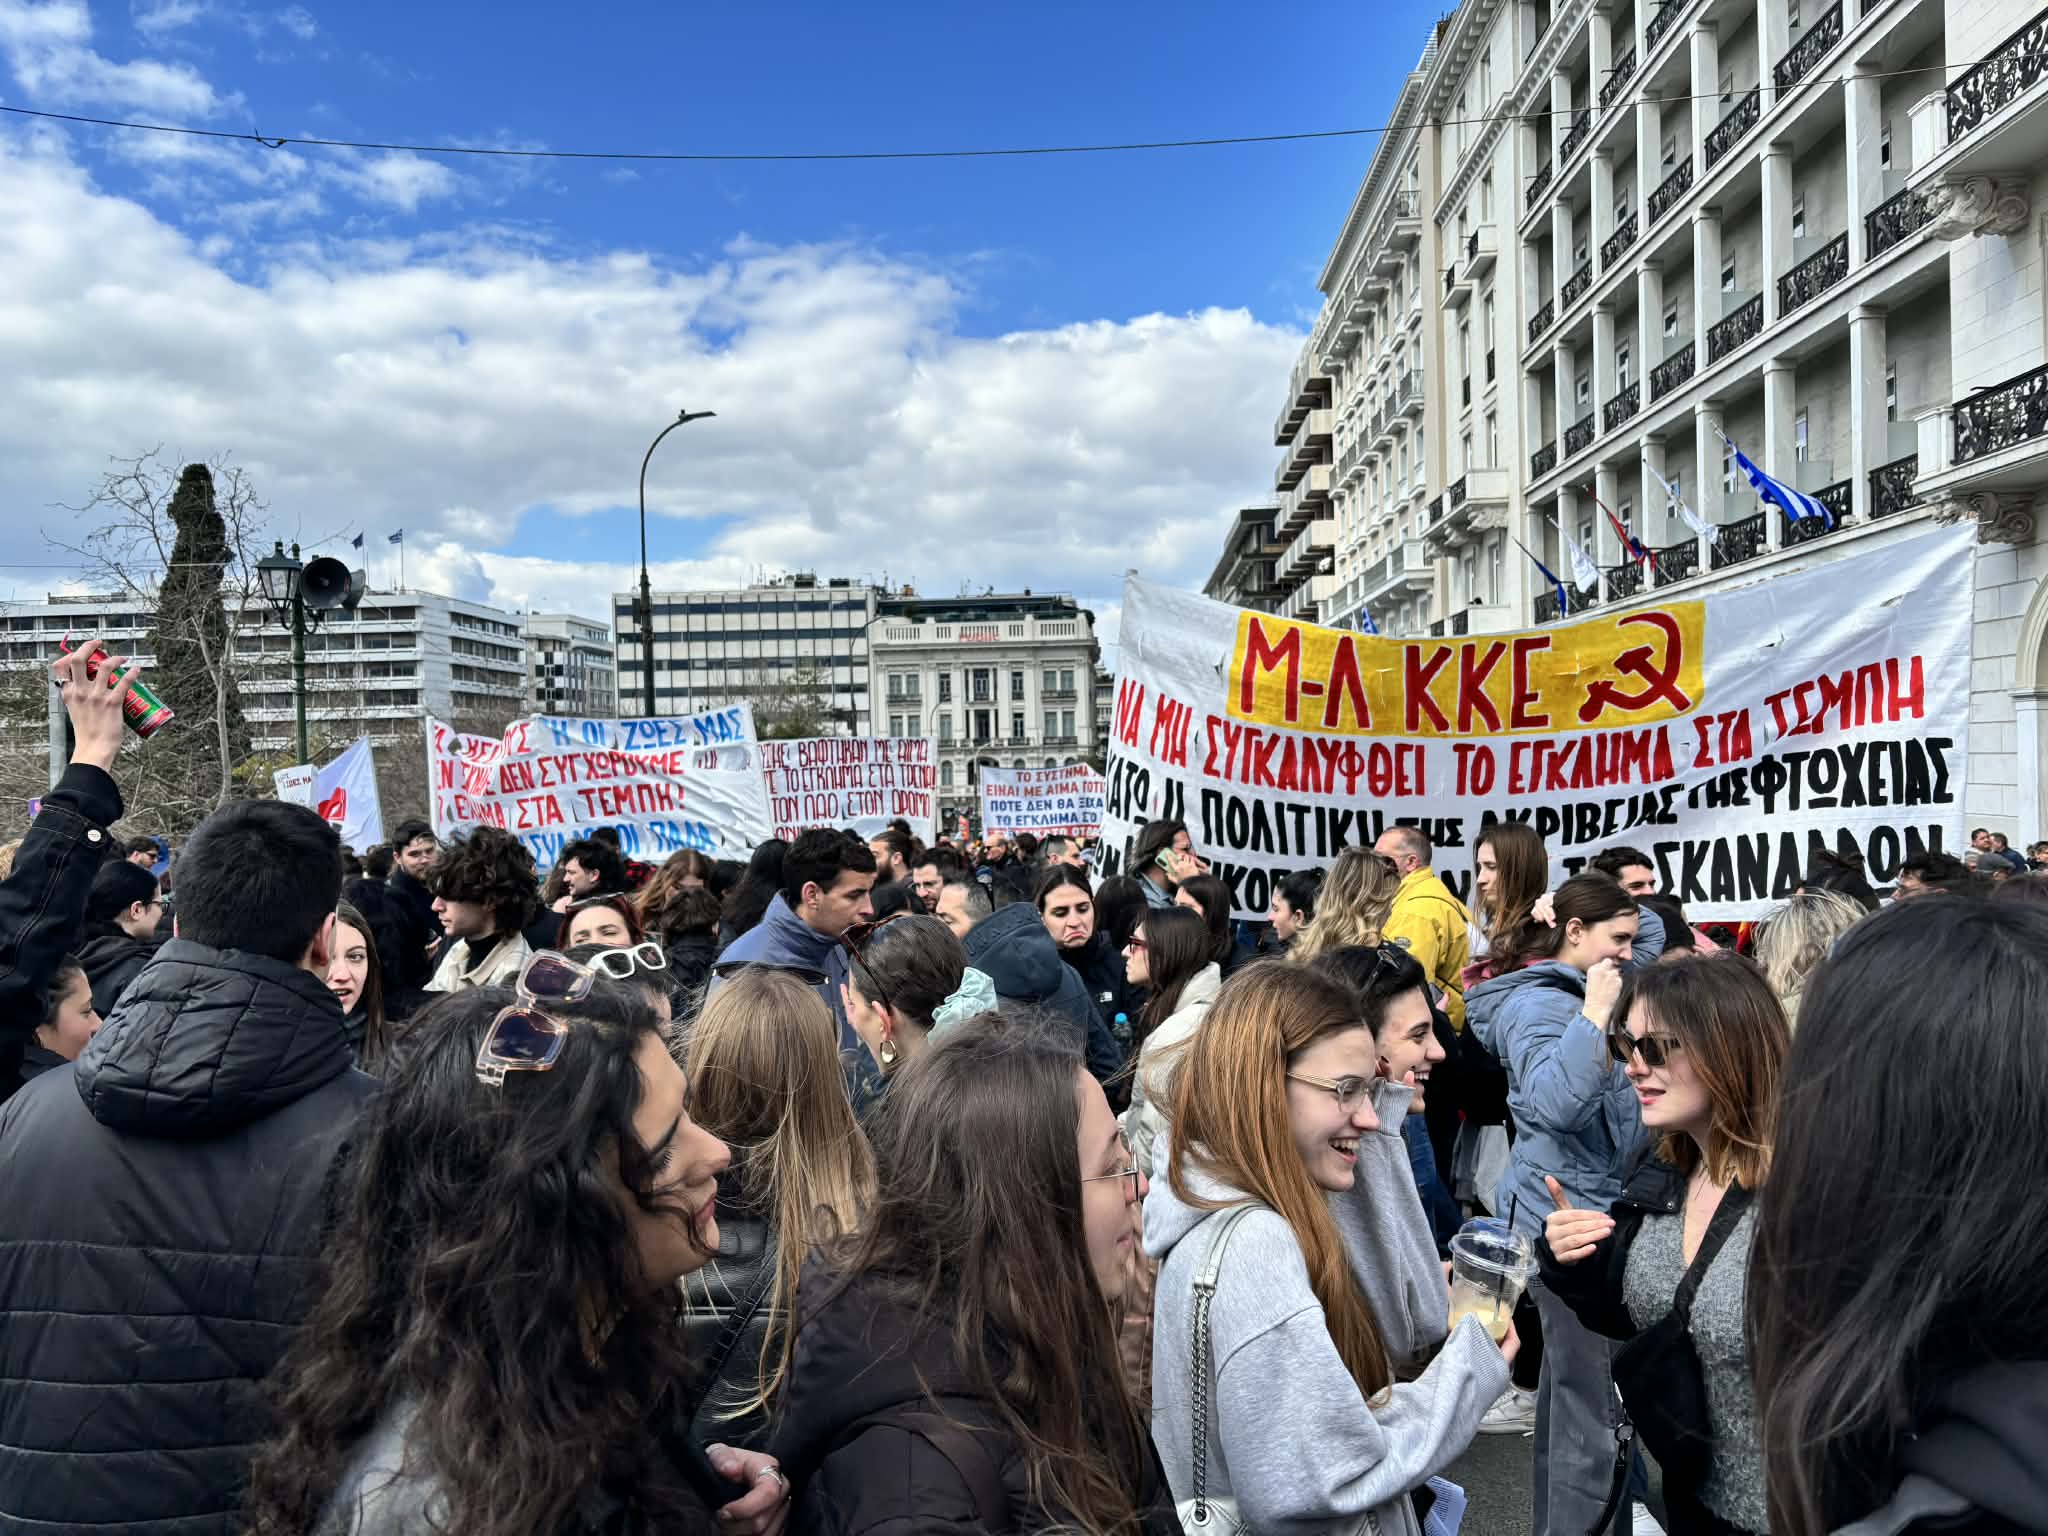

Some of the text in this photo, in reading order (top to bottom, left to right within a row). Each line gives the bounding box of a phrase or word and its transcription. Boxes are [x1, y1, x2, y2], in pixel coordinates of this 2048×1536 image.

[1240, 616, 1552, 734] Μ-Λ ΚΚΕ
[582, 720, 606, 746] ΟΙ
[621, 720, 687, 751] ΖΩΕΣ
[693, 708, 745, 746] ΜΑΣ
[1113, 655, 1925, 797] ΝΑ ΜΗ ΣΥΓΚΑΛΥΦΘΕΙ ΤΟ ΕΓΚΛΗΜΑ ΣΤΑ ΤΕΜΠΗ
[799, 739, 868, 767] ΒΑΦΤΗΚΑΝ
[874, 739, 893, 763] ΜΕ
[897, 739, 928, 763] ΑΙΜΑ
[500, 760, 535, 794] ΔΕΝ
[538, 750, 684, 787] ΣΥΓΧΩΡΟΥΜΕ
[783, 768, 799, 793] ΤΟ
[802, 765, 863, 792] ΕΓΚΛΗΜΑ
[1015, 766, 1089, 783] ΤΟ ΣΥΣΤΗΜΑ
[986, 784, 1020, 797] ΕΙΝΑΙ
[1023, 785, 1042, 797] ΜΕ
[1046, 781, 1079, 796] ΑΙΜΑ
[1201, 788, 1383, 857] ΠΟΛΙΤΙΚΗ
[1688, 767, 1751, 809] ΤΗΣ
[1751, 737, 1953, 815] ΦΤΩΧΕΙΑΣ
[517, 794, 565, 829] ΣΤΑ
[577, 783, 685, 818] ΤΕΜΠΗ!
[771, 796, 799, 823] ΤΟΝ
[804, 793, 839, 821] ΛΑΟ
[990, 800, 1023, 813] ΠΟΤΕ
[1026, 799, 1052, 811] ΔΕΝ
[1057, 798, 1075, 809] ΘΑ
[995, 815, 1011, 827] ΤΟ
[1015, 812, 1079, 827] ΕΓΚΛΗΜΑ
